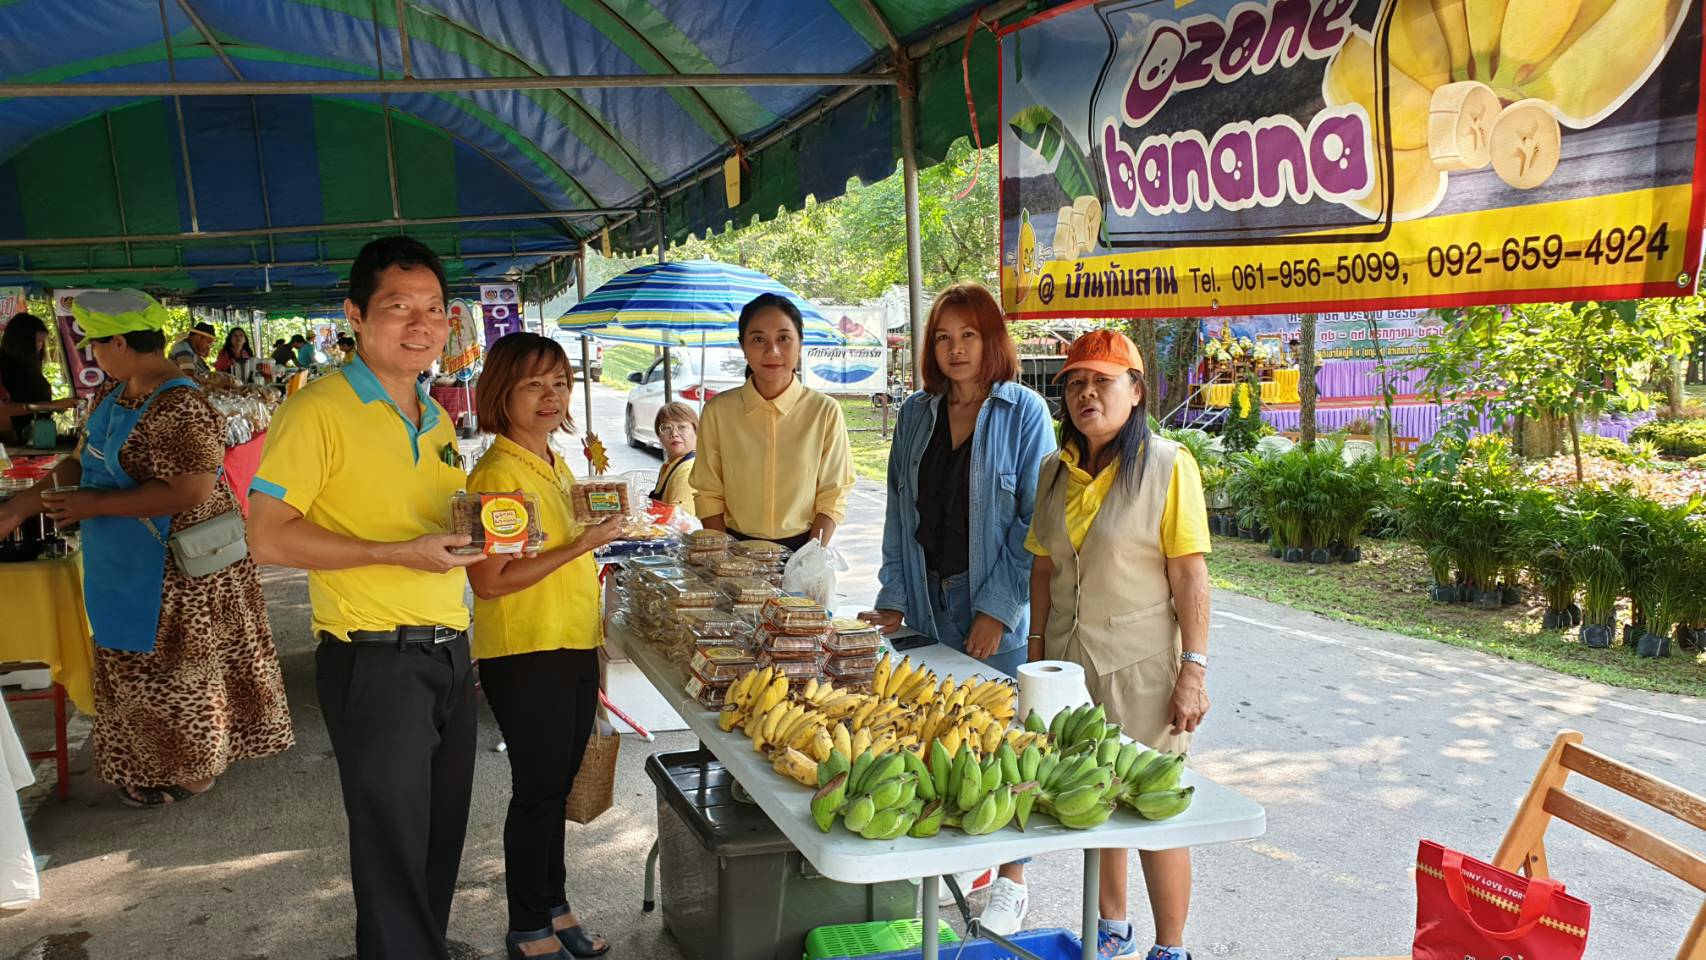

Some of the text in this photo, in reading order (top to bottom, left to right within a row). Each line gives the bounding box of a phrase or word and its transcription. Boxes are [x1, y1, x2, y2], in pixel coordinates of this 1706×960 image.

[1122, 0, 1352, 124] Ozone
[1104, 107, 1371, 213] banana
[1038, 222, 1669, 305] @ บ้านทับลาน Tel. 061-956-5099, 092-659-4924
[1481, 878, 1503, 892] LOVE
